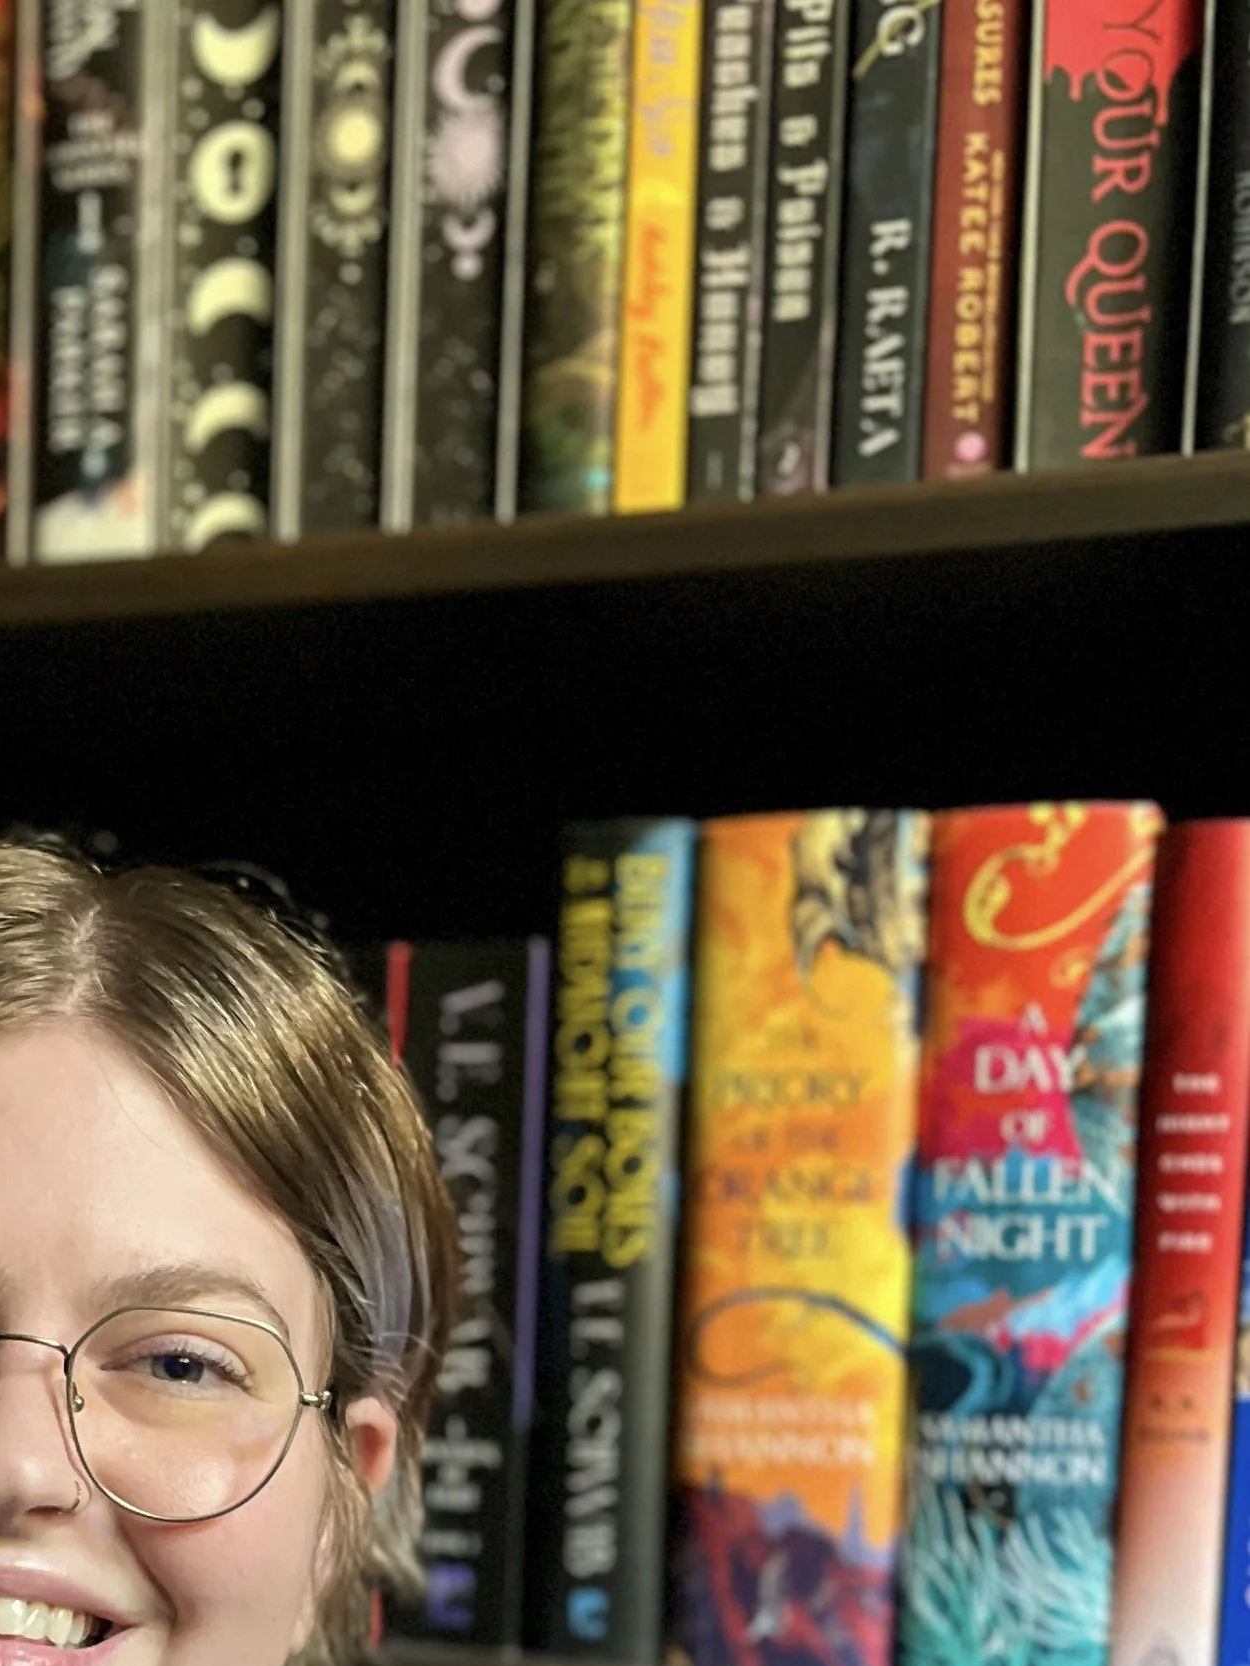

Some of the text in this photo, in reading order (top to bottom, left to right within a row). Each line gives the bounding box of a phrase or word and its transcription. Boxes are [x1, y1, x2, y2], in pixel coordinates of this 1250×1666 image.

[708, 0, 759, 171] eaches
[972, 0, 1006, 105] SURES
[1065, 4, 1164, 461] YOUR QUEEN
[950, 131, 991, 423] KATEE ROBERT
[859, 219, 911, 457] R. RAETA
[1018, 1001, 1048, 1037] A
[973, 1045, 1087, 1095] DAY
[999, 1108, 1054, 1144] OF
[934, 1158, 1126, 1219] FALLEN
[935, 1213, 1110, 1263] NIGHT
